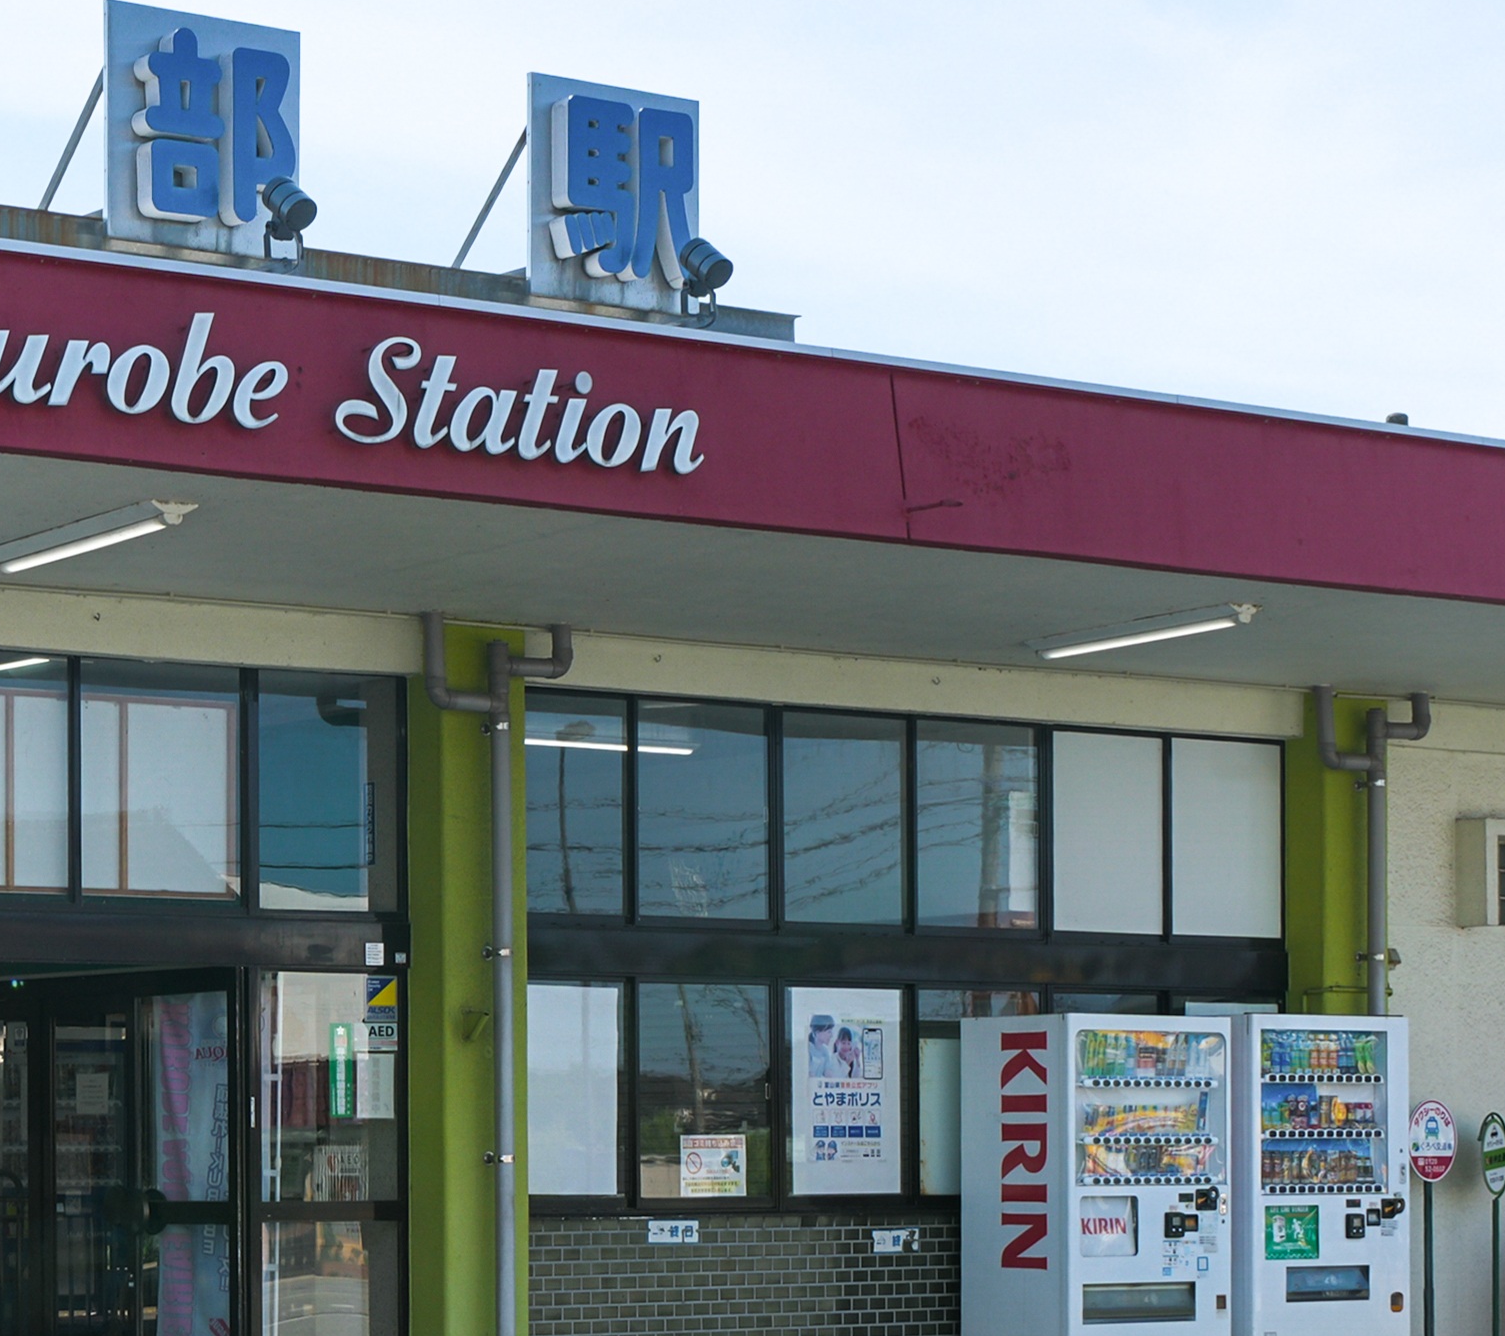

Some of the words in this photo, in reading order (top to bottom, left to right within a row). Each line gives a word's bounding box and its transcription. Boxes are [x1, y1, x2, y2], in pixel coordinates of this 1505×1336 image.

[334, 335, 707, 477] Station
[367, 1006, 396, 1015] ALSOK
[369, 1025, 395, 1037] AED
[812, 1091, 882, 1107] とやまポリス
[1414, 1107, 1451, 1128] タクシーのりば
[1000, 1031, 1048, 1270] KIRIN
[1080, 1217, 1127, 1236] KIRIN
